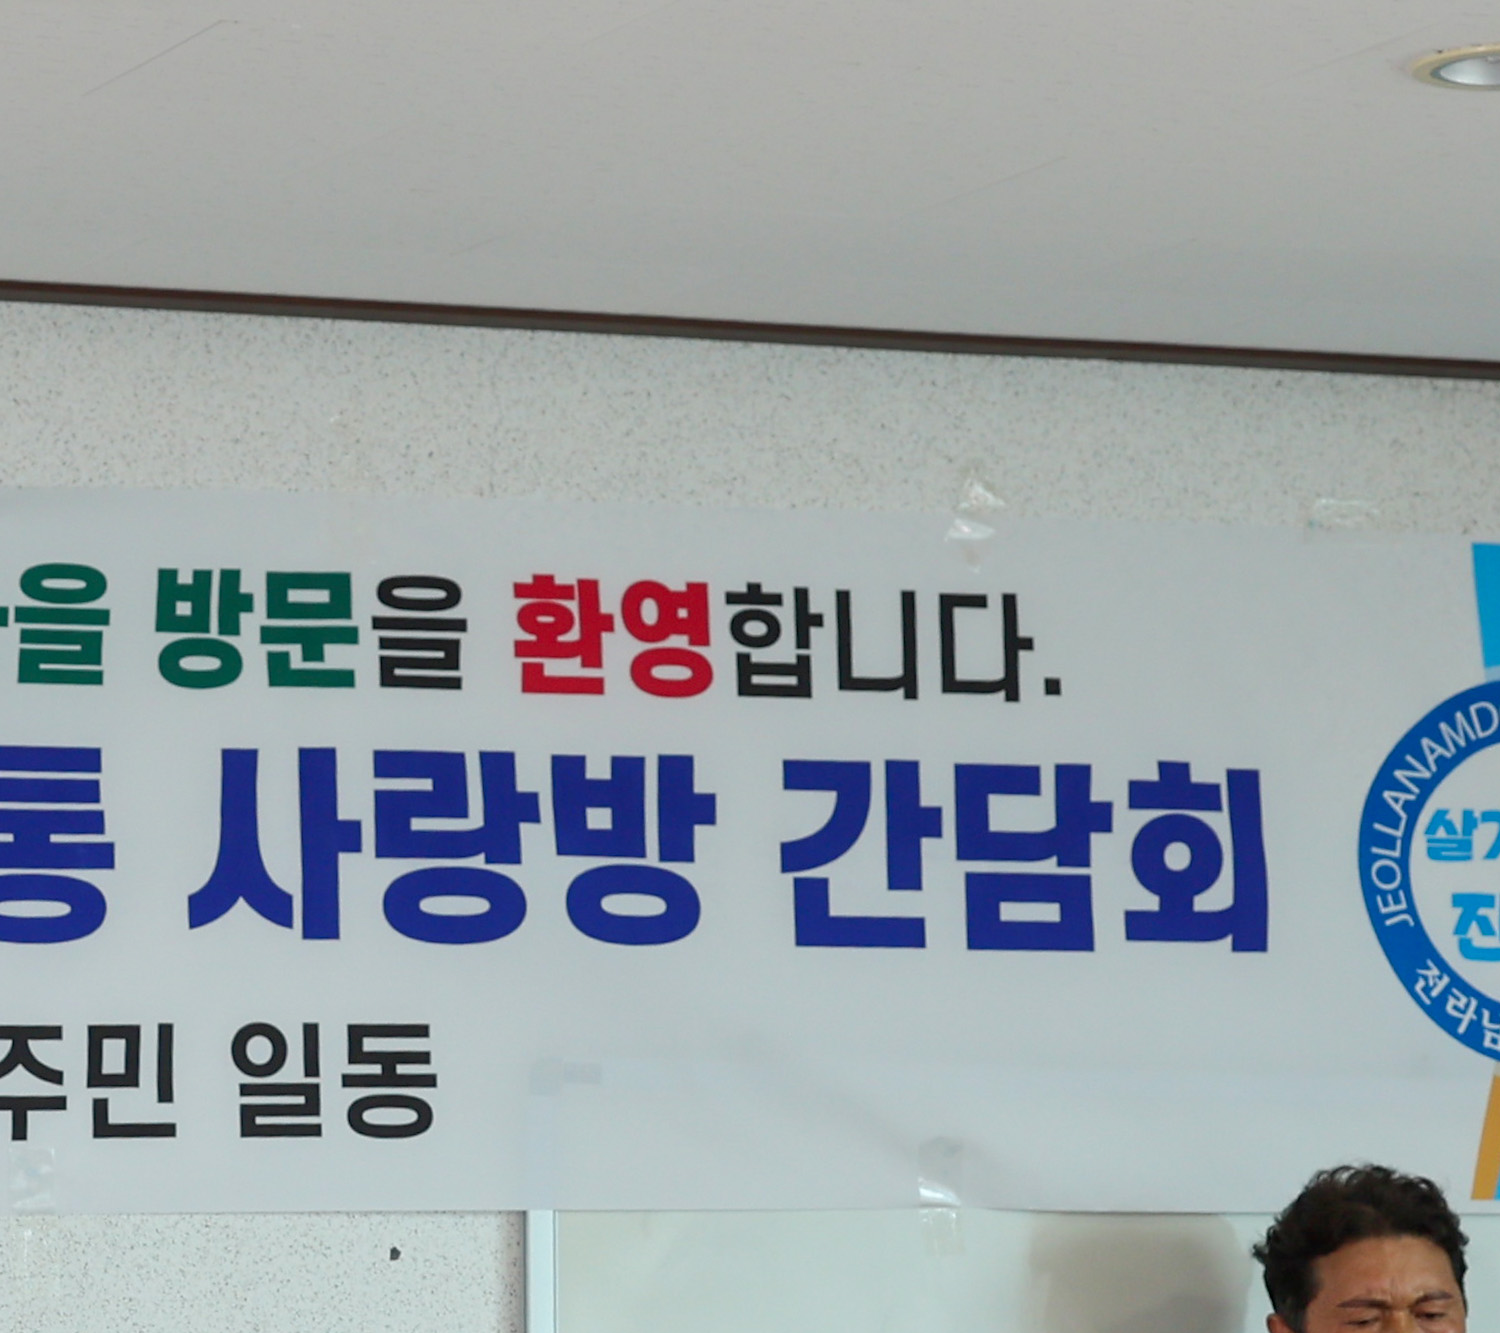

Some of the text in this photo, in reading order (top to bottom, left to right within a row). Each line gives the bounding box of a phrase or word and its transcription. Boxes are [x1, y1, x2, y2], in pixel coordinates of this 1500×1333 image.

[154, 567, 468, 691] 방문을
[512, 573, 1062, 704] 환영합니다.
[187, 746, 717, 947] 사랑방
[779, 758, 1270, 954] 간담회
[230, 1021, 438, 1140] 일동
